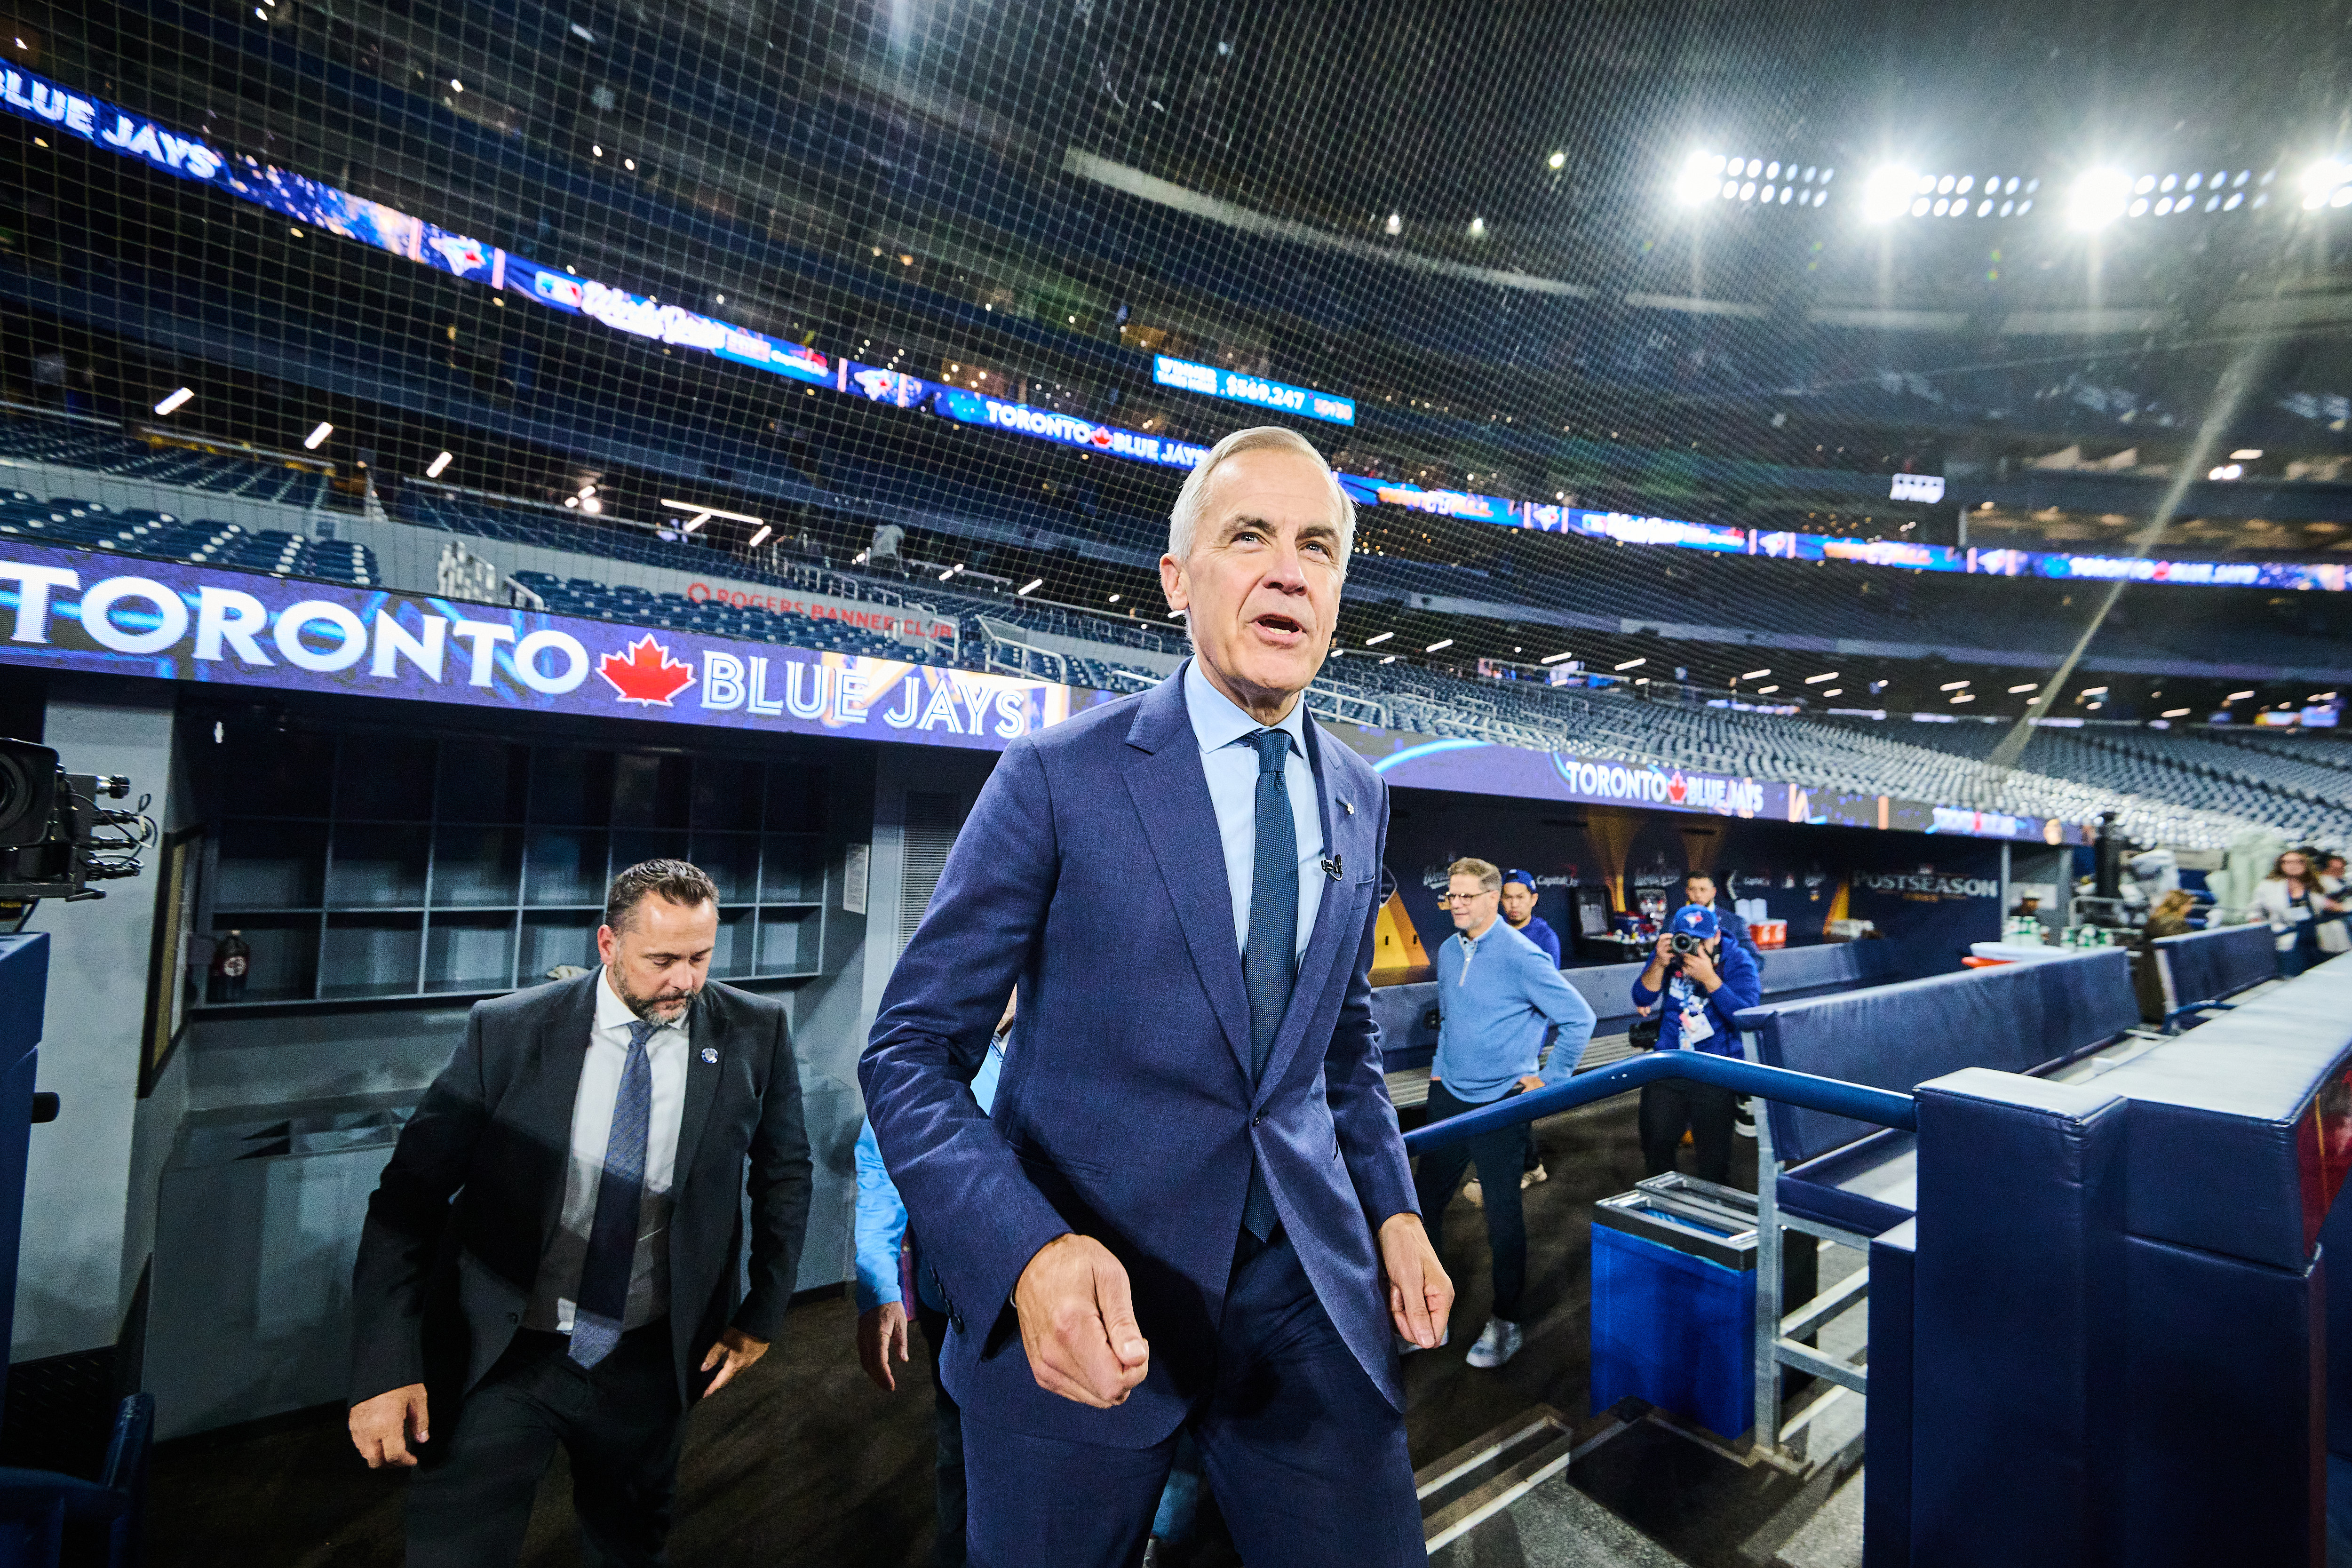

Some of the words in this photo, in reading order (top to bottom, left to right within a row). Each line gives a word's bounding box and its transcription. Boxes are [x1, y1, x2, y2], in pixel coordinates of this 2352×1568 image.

[0, 69, 95, 140] LUE
[101, 115, 222, 178] JAYS
[985, 400, 1091, 444] TORONTO
[1113, 432, 1159, 461] BLUE
[1160, 443, 1210, 467] JAYS
[716, 589, 804, 614] ROGERS
[810, 604, 895, 630] BANNER
[0, 561, 589, 694] TORONTO
[700, 650, 869, 724] BLUE
[883, 677, 1025, 738] JAYS
[1565, 761, 1667, 803] TORONTO
[1687, 776, 1726, 808] BLUE
